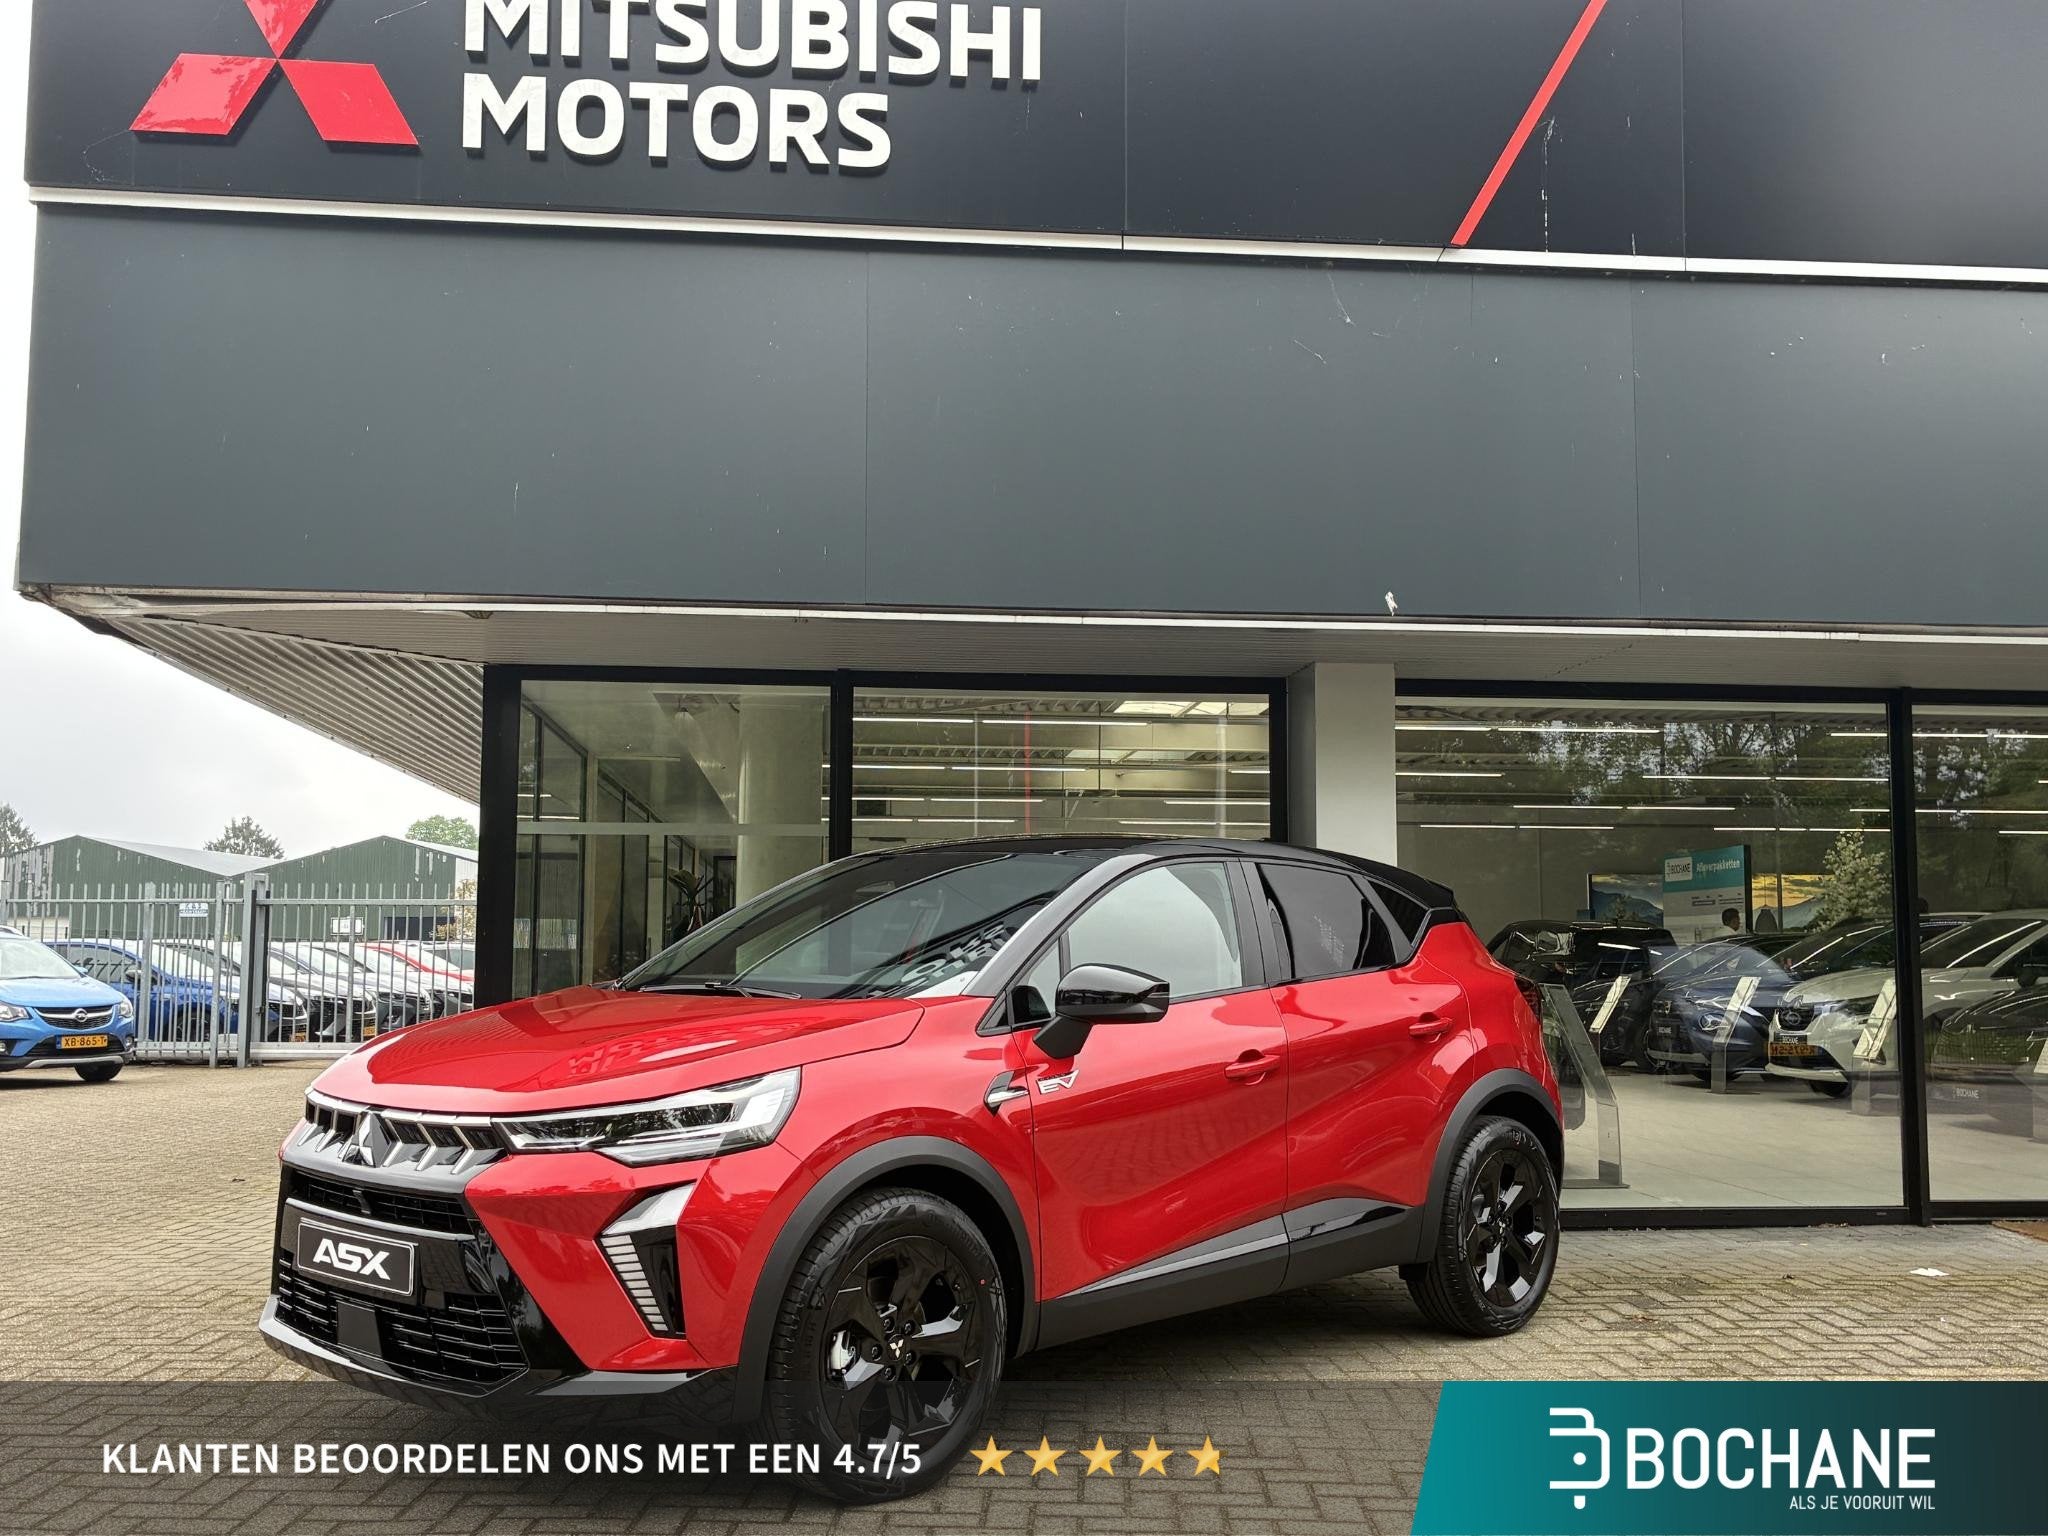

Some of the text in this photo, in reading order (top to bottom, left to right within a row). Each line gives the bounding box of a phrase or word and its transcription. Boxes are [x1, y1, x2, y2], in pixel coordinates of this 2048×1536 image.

[464, 0, 1042, 80] MITSUBISHI
[462, 72, 892, 168] MOTORS
[1038, 1069, 1079, 1094] EV
[312, 1238, 391, 1281] ASX
